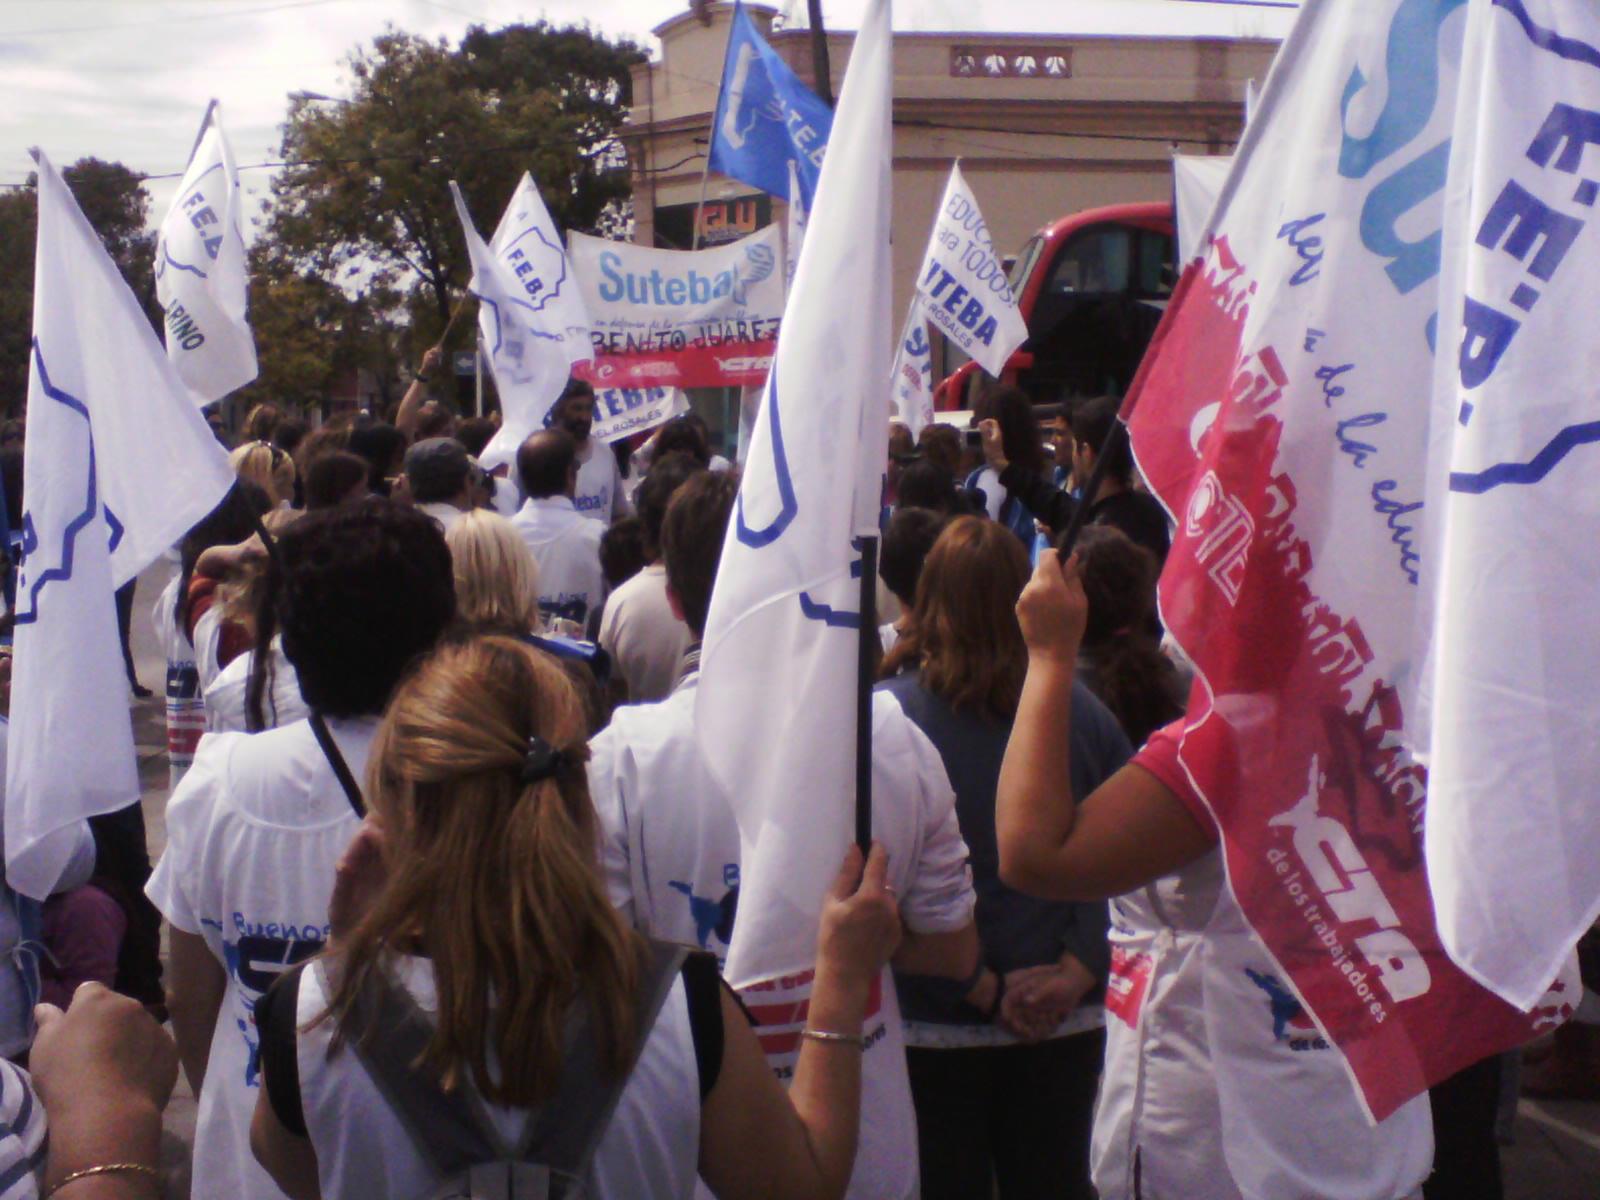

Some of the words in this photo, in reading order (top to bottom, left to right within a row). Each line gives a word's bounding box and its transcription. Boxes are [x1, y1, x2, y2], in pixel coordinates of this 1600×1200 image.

[507, 248, 544, 301] F.E.B.
[1335, 412, 1388, 469] la
[1266, 847, 1291, 876] de
[1282, 871, 1310, 906] los
[1303, 904, 1387, 1024] trabajadores
